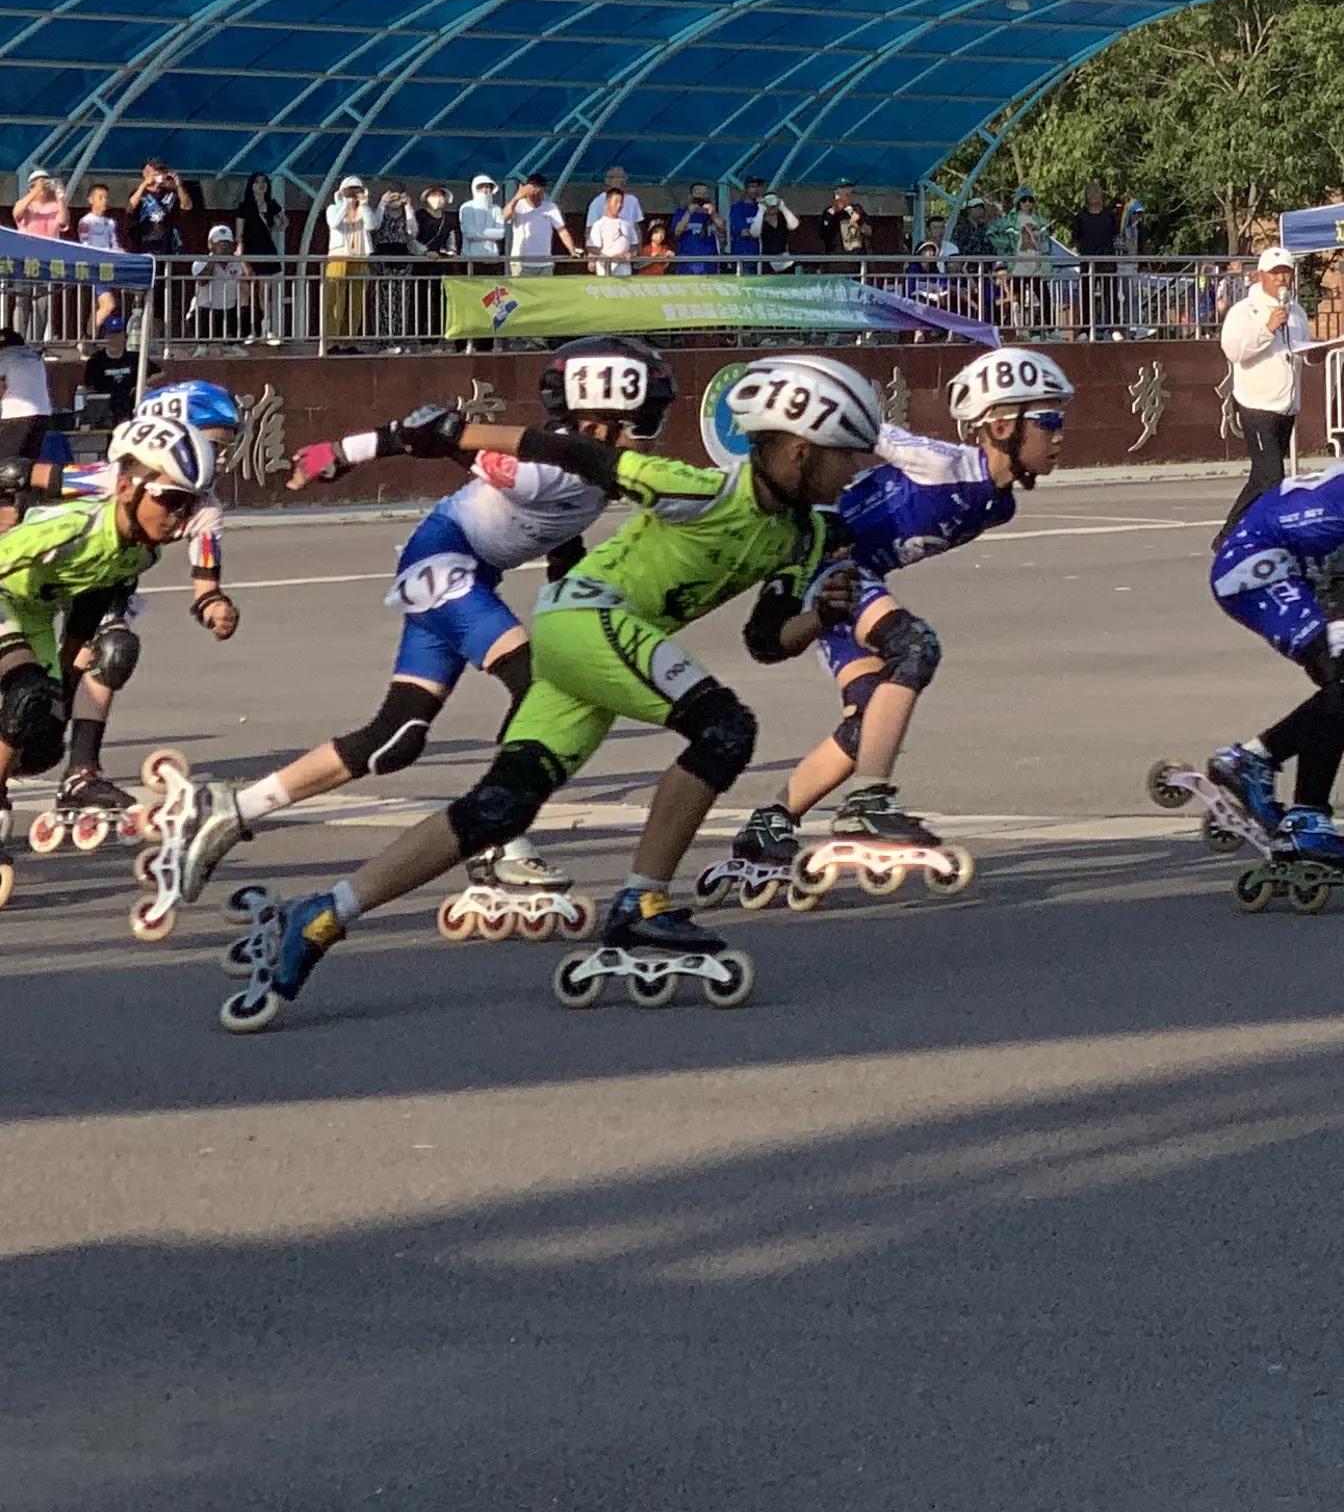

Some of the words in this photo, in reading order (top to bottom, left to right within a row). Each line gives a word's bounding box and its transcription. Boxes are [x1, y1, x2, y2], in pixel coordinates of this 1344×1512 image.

[571, 365, 641, 401] 113
[976, 360, 1038, 394] 180
[764, 379, 838, 432] 197
